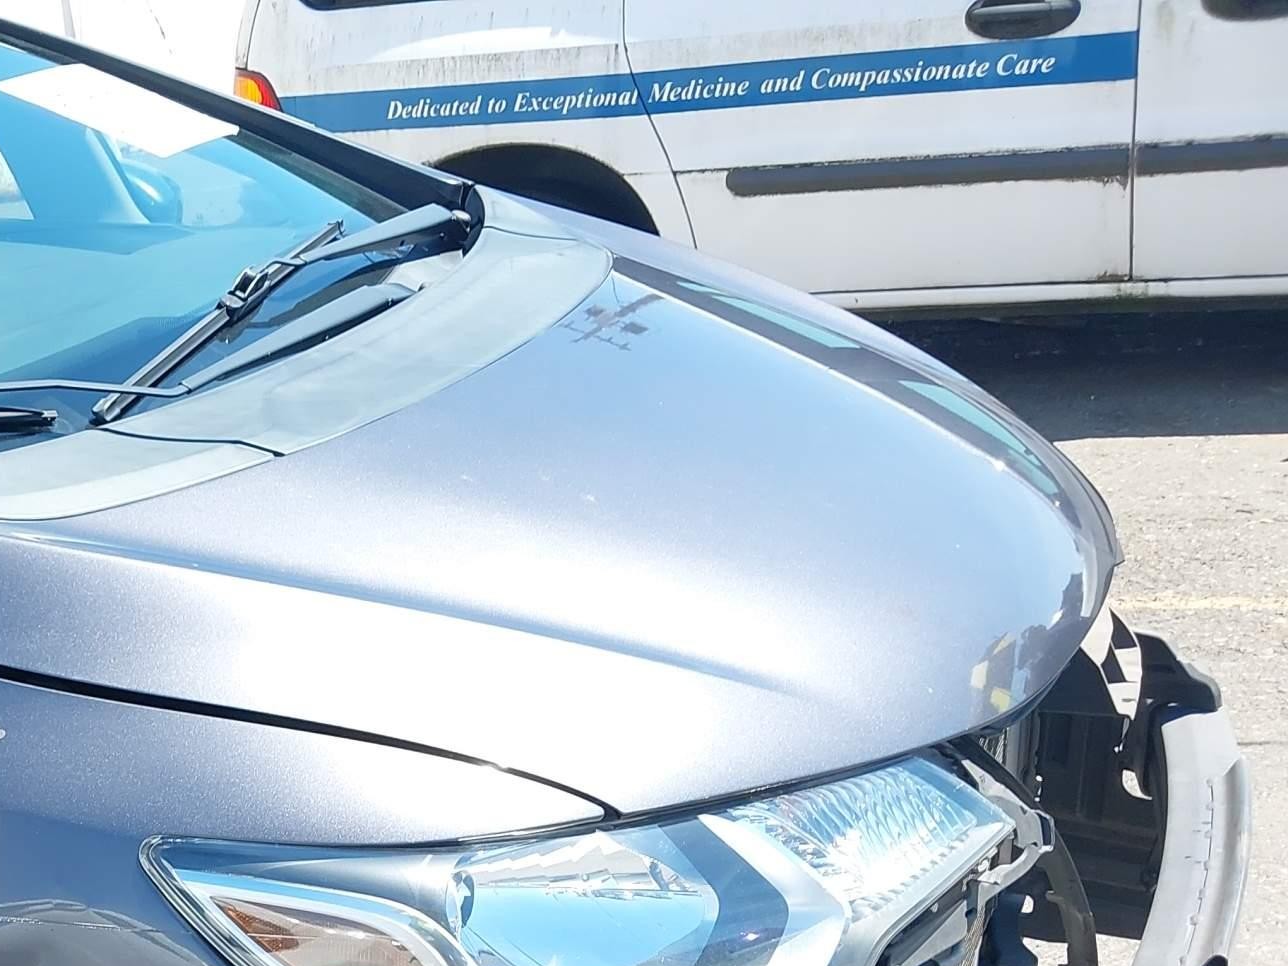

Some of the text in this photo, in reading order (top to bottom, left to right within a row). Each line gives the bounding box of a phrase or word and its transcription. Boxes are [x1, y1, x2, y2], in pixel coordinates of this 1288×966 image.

[386, 53, 1056, 120] Dedicated to Exceptional Medicine and Compassionate Care
